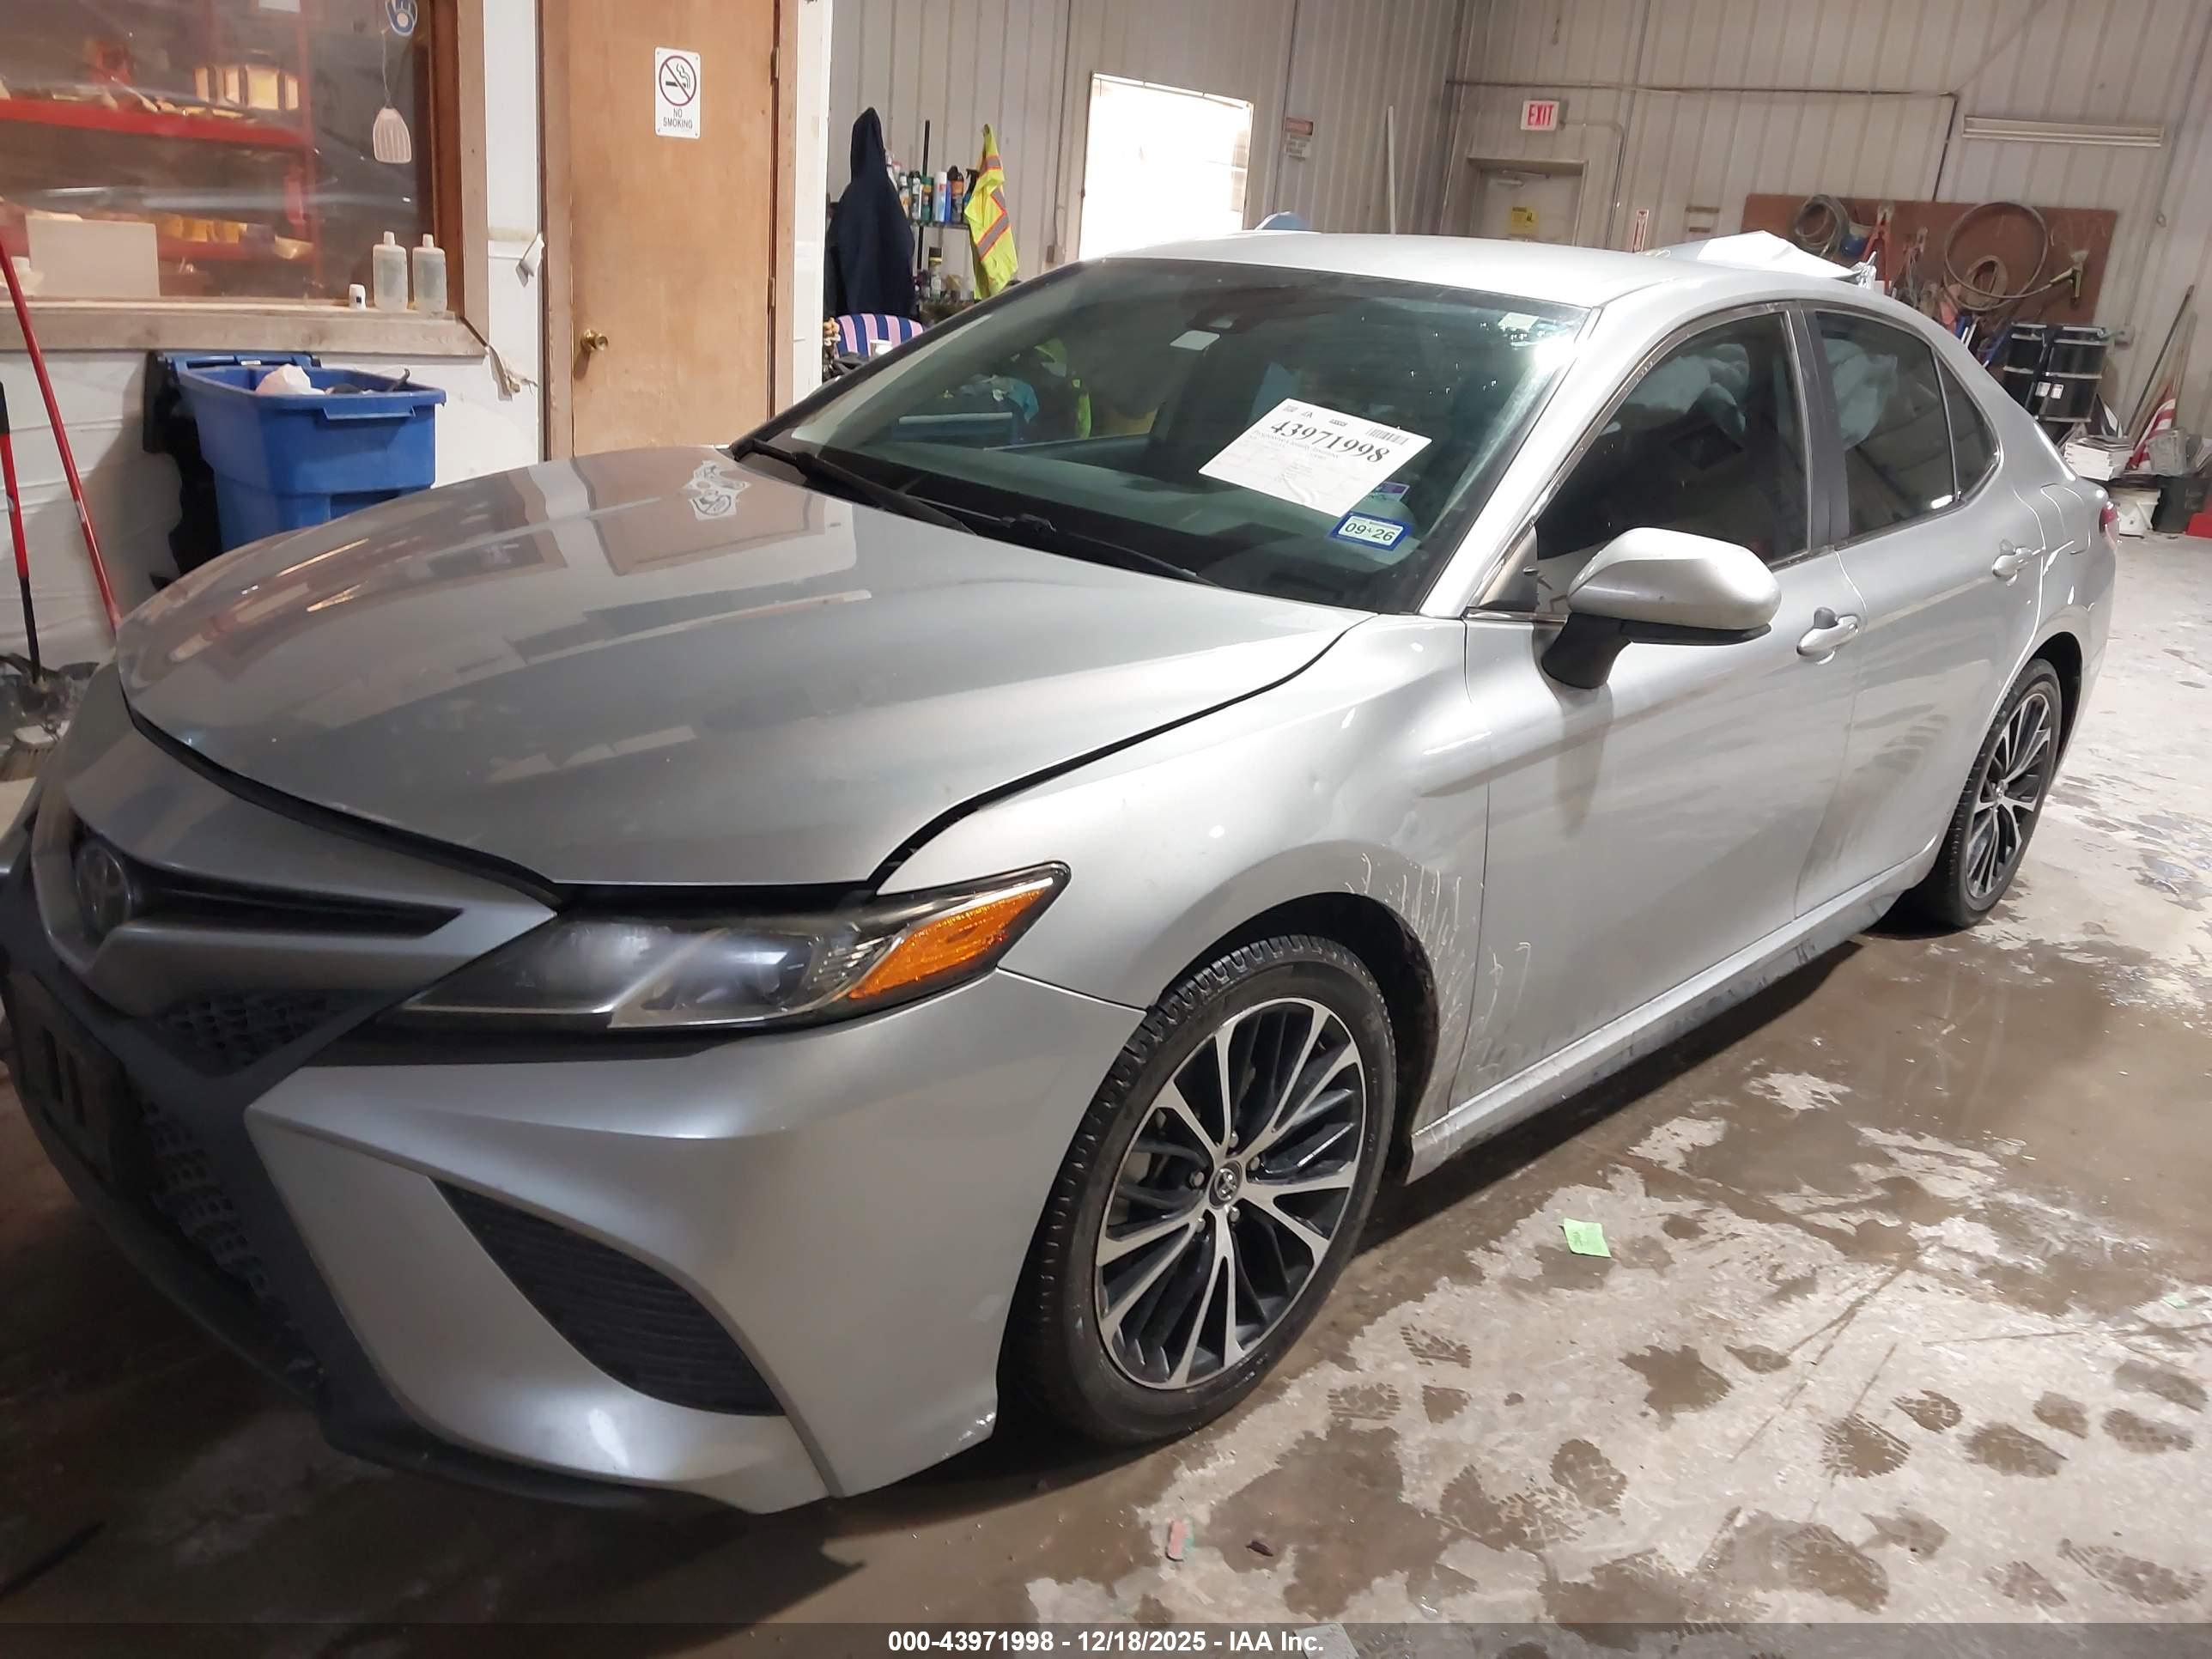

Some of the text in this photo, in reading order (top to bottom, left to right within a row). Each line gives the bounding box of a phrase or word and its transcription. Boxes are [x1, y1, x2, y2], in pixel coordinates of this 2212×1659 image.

[673, 108, 683, 118] NO
[1528, 104, 1554, 126] EXIT
[663, 117, 693, 130] SMOKING
[1271, 421, 1390, 463] 43971998
[1345, 522, 1395, 542] 09 26
